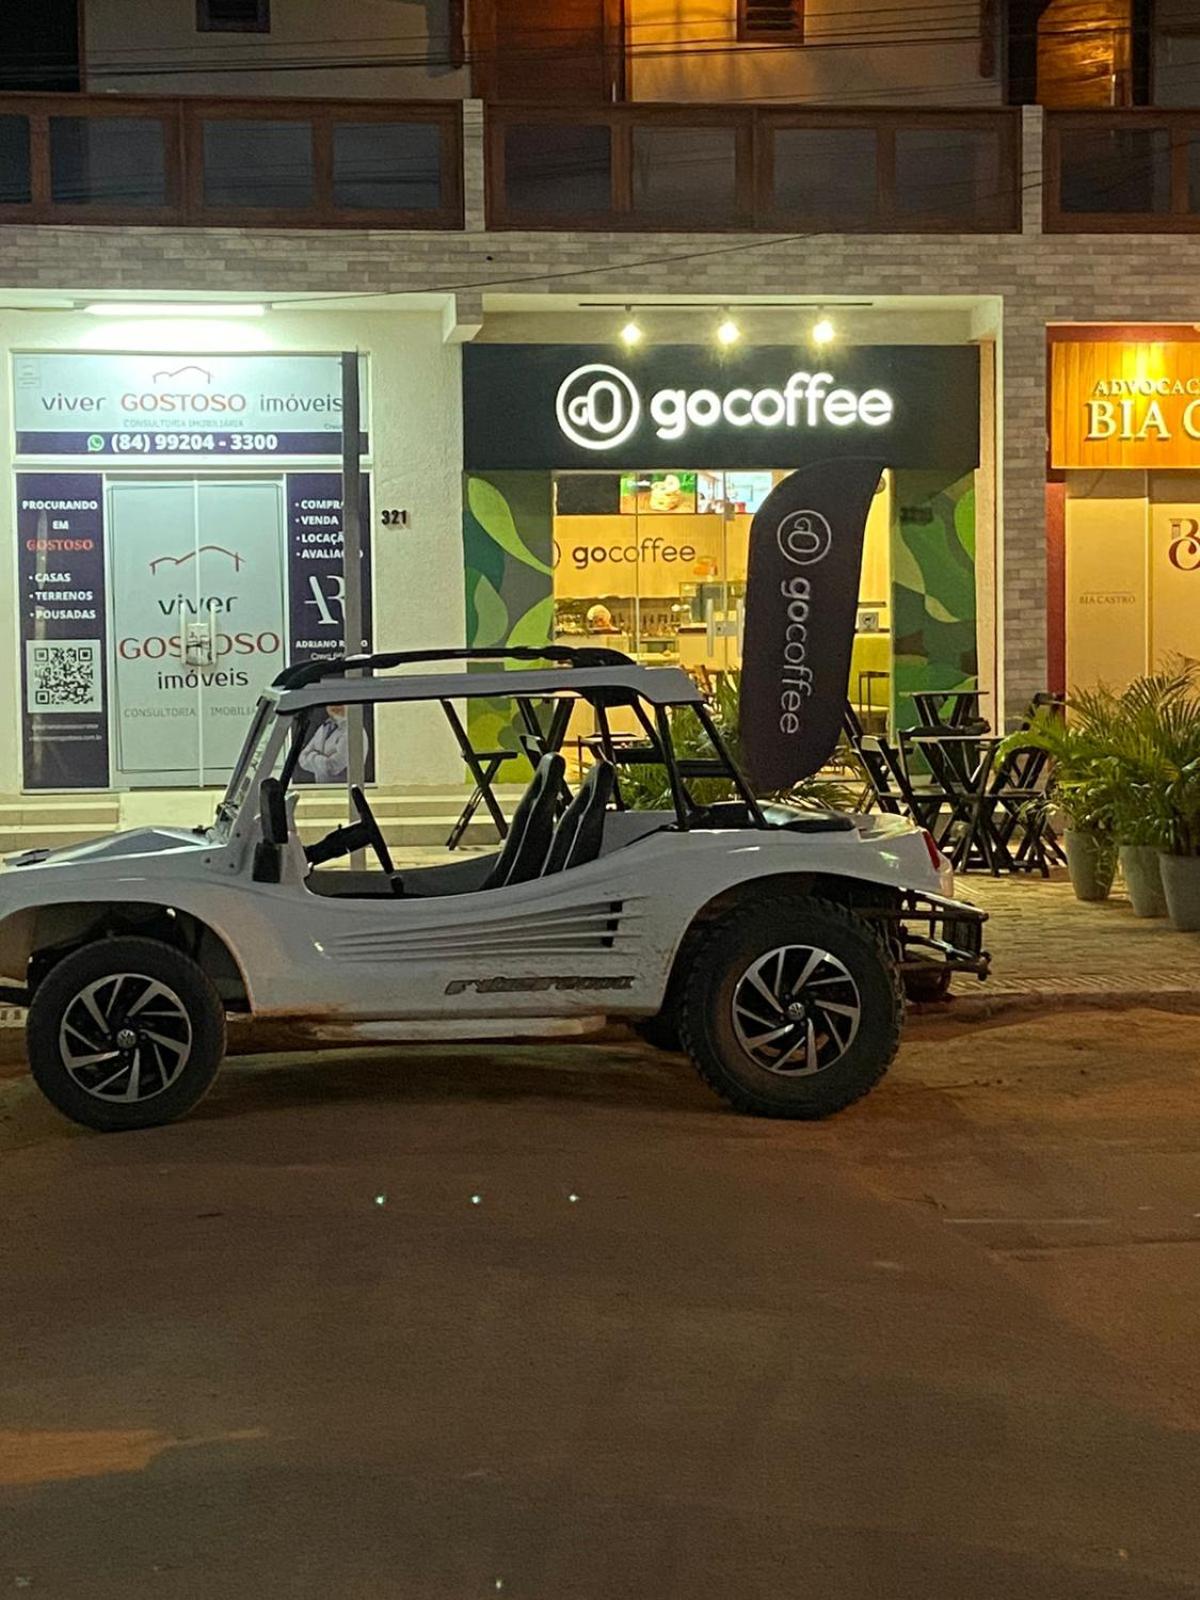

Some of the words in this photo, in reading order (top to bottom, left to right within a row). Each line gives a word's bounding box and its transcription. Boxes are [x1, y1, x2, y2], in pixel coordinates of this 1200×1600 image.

[41, 393, 107, 411] viver
[121, 393, 246, 412] GOSTOSO
[260, 393, 343, 412] imóveis
[650, 372, 893, 439] gocoffee
[1086, 400, 1172, 438] BIA
[111, 433, 151, 452] (84)
[155, 434, 215, 450] 99204
[230, 434, 278, 450] 3300
[22, 500, 98, 510] PROCURANDO
[301, 515, 339, 525] VENDA
[381, 509, 407, 525] 321
[52, 520, 70, 530] EM
[302, 531, 344, 545] LOCAÇÃ
[26, 540, 94, 551] GOSTOSO
[302, 549, 364, 559] AVALIA
[572, 537, 696, 570] gocoffee
[35, 573, 71, 582] CASAS
[35, 591, 93, 601] TERRENOS
[158, 594, 238, 616] viver
[35, 609, 97, 620] POUSADAS
[119, 631, 280, 660] GOSOSO
[296, 640, 337, 649] ADRIANO
[780, 577, 813, 734] gocoffee
[157, 668, 249, 690] imóveis
[124, 706, 197, 718] CONSULTORIA
